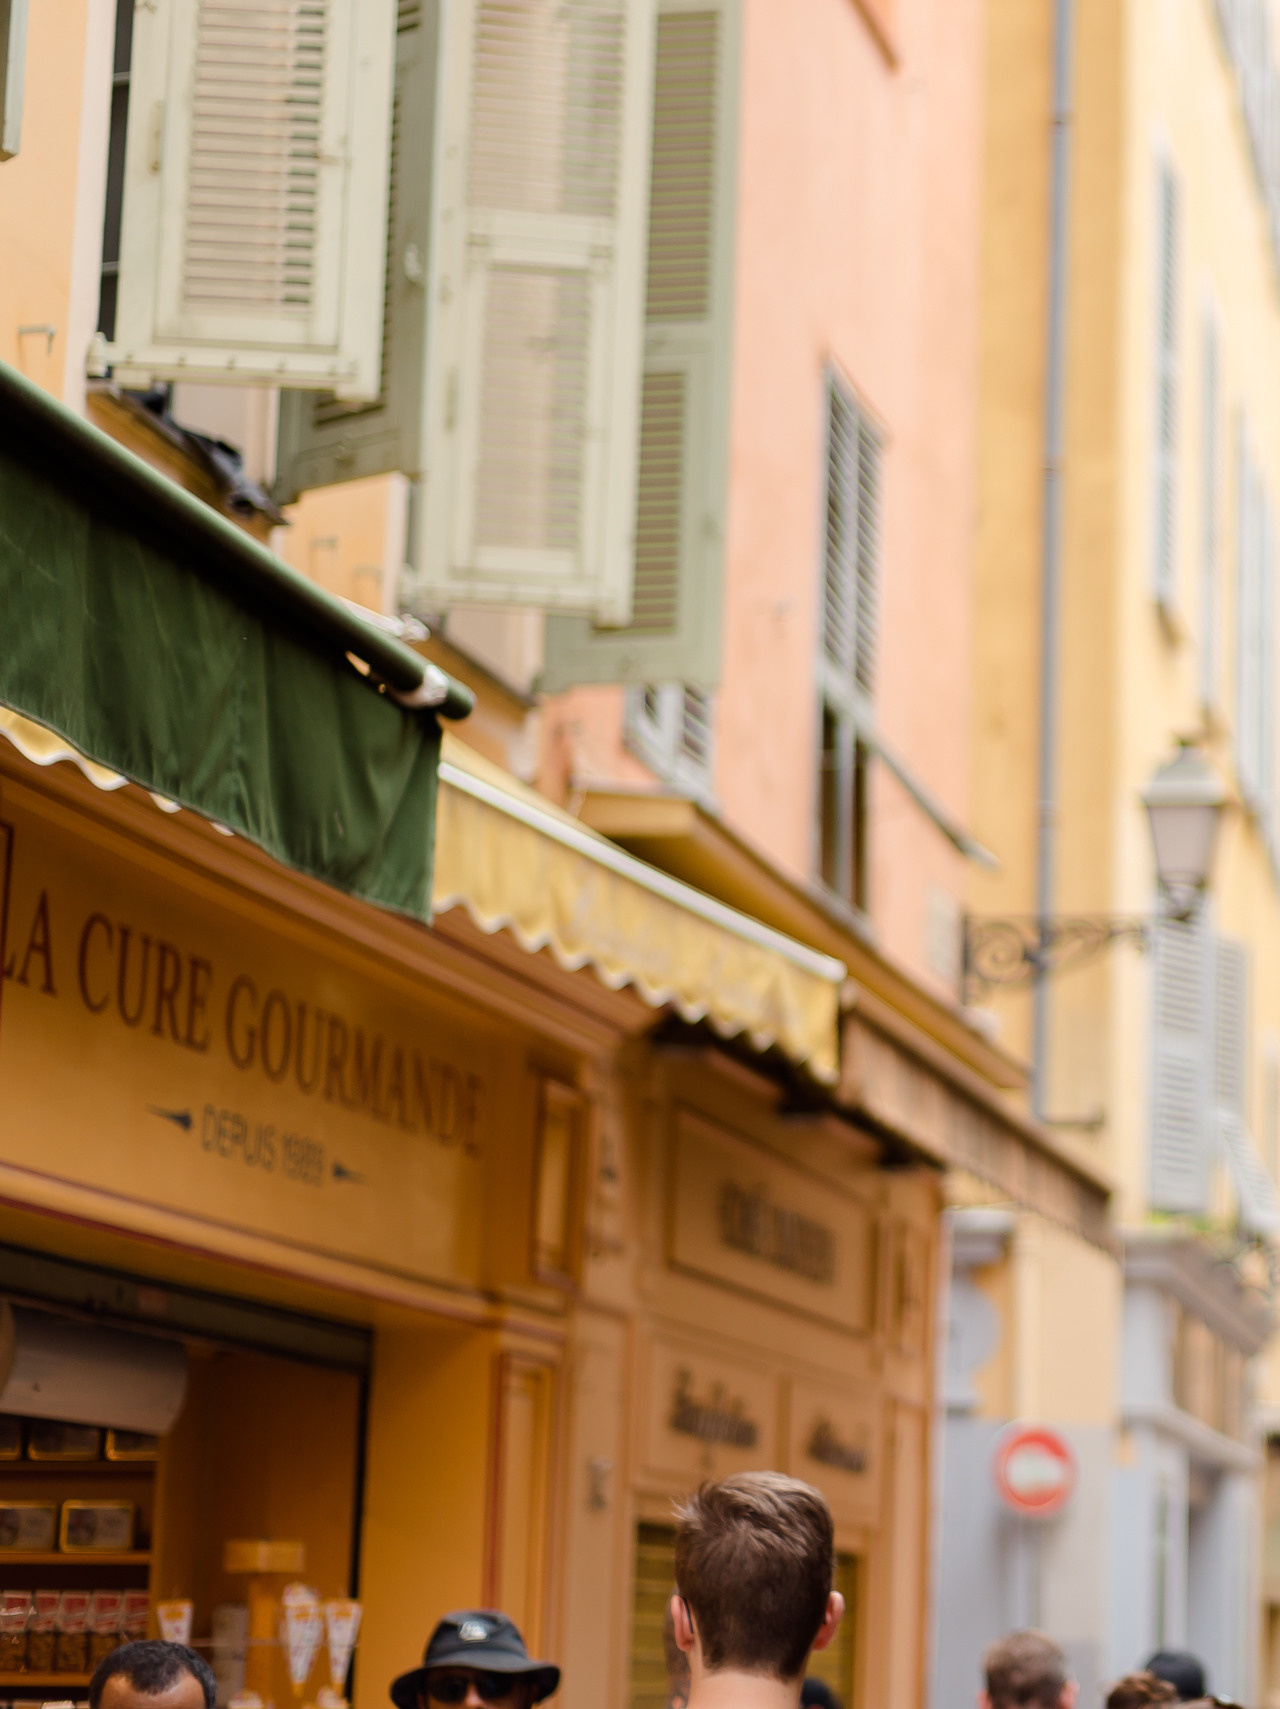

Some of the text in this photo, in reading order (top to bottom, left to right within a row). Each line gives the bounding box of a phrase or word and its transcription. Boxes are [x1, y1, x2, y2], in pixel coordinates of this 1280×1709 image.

[77, 911, 213, 1055] CURE
[224, 972, 487, 1160] GOURMANDE
[201, 1102, 277, 1173] DEPUIS
